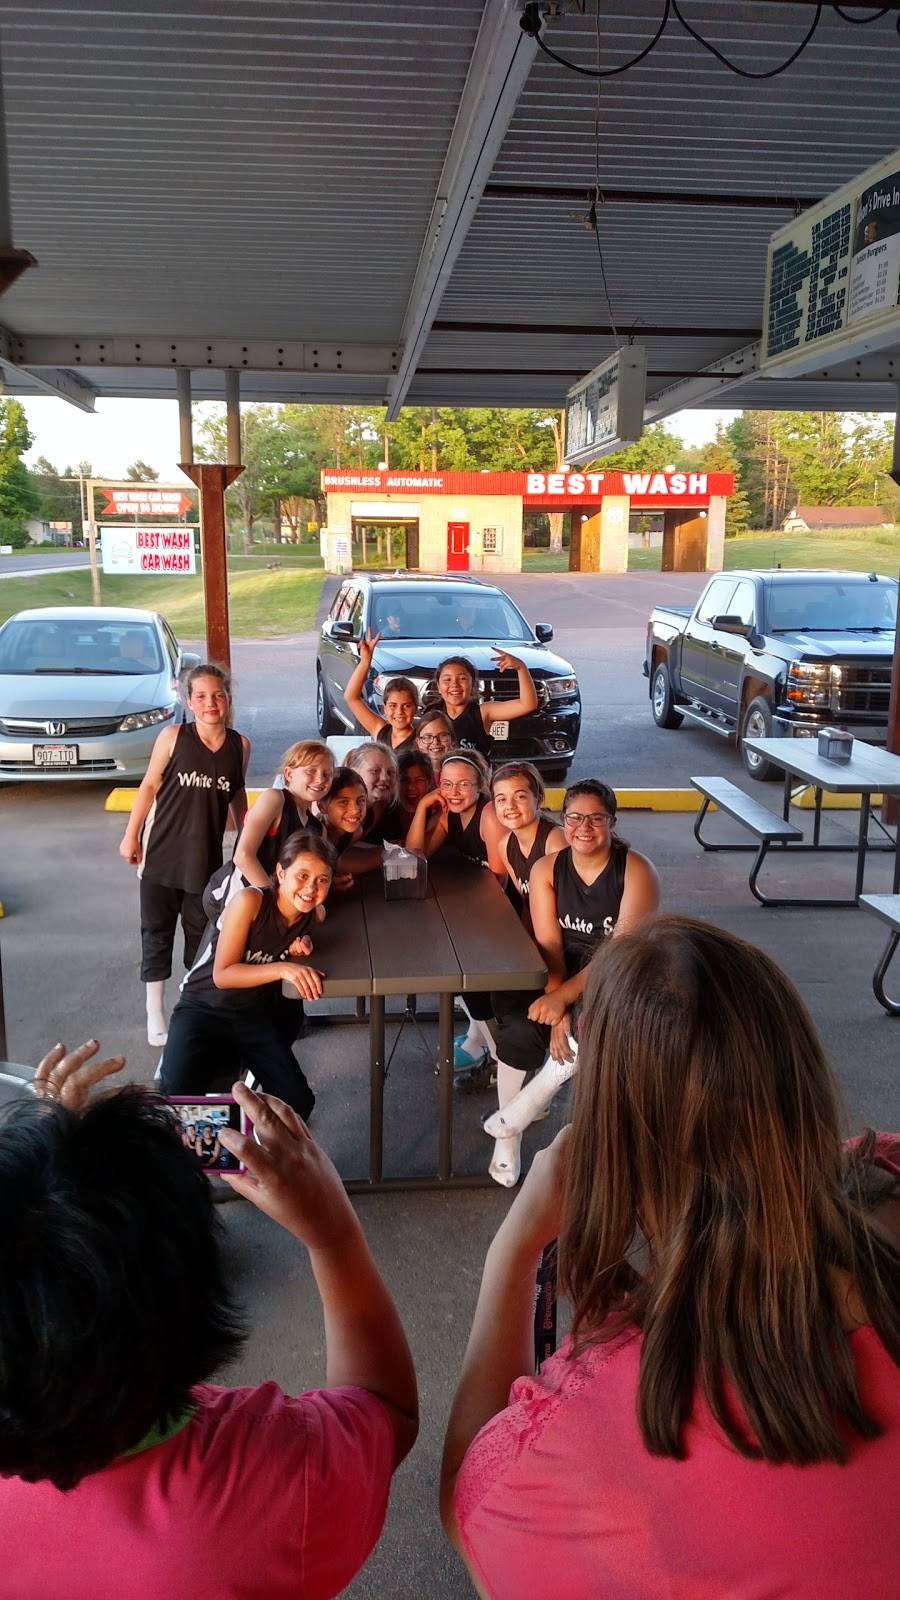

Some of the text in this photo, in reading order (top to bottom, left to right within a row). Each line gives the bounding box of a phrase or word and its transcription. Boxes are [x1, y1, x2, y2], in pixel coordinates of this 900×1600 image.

[873, 192, 891, 211] Drive
[892, 187, 900, 206] In
[325, 476, 443, 487] BRUSHLESS AUTOMATIC
[527, 473, 707, 496] BEST WASH
[112, 492, 181, 503] BEST WASH CAR WASH
[116, 502, 179, 513] OPEN 24 HOURS
[136, 532, 190, 550] BEST WASH
[141, 554, 190, 571] CAR WASH
[177, 770, 213, 789] White
[603, 916, 613, 936] S
[544, 1281, 553, 1321] Husqvarna
